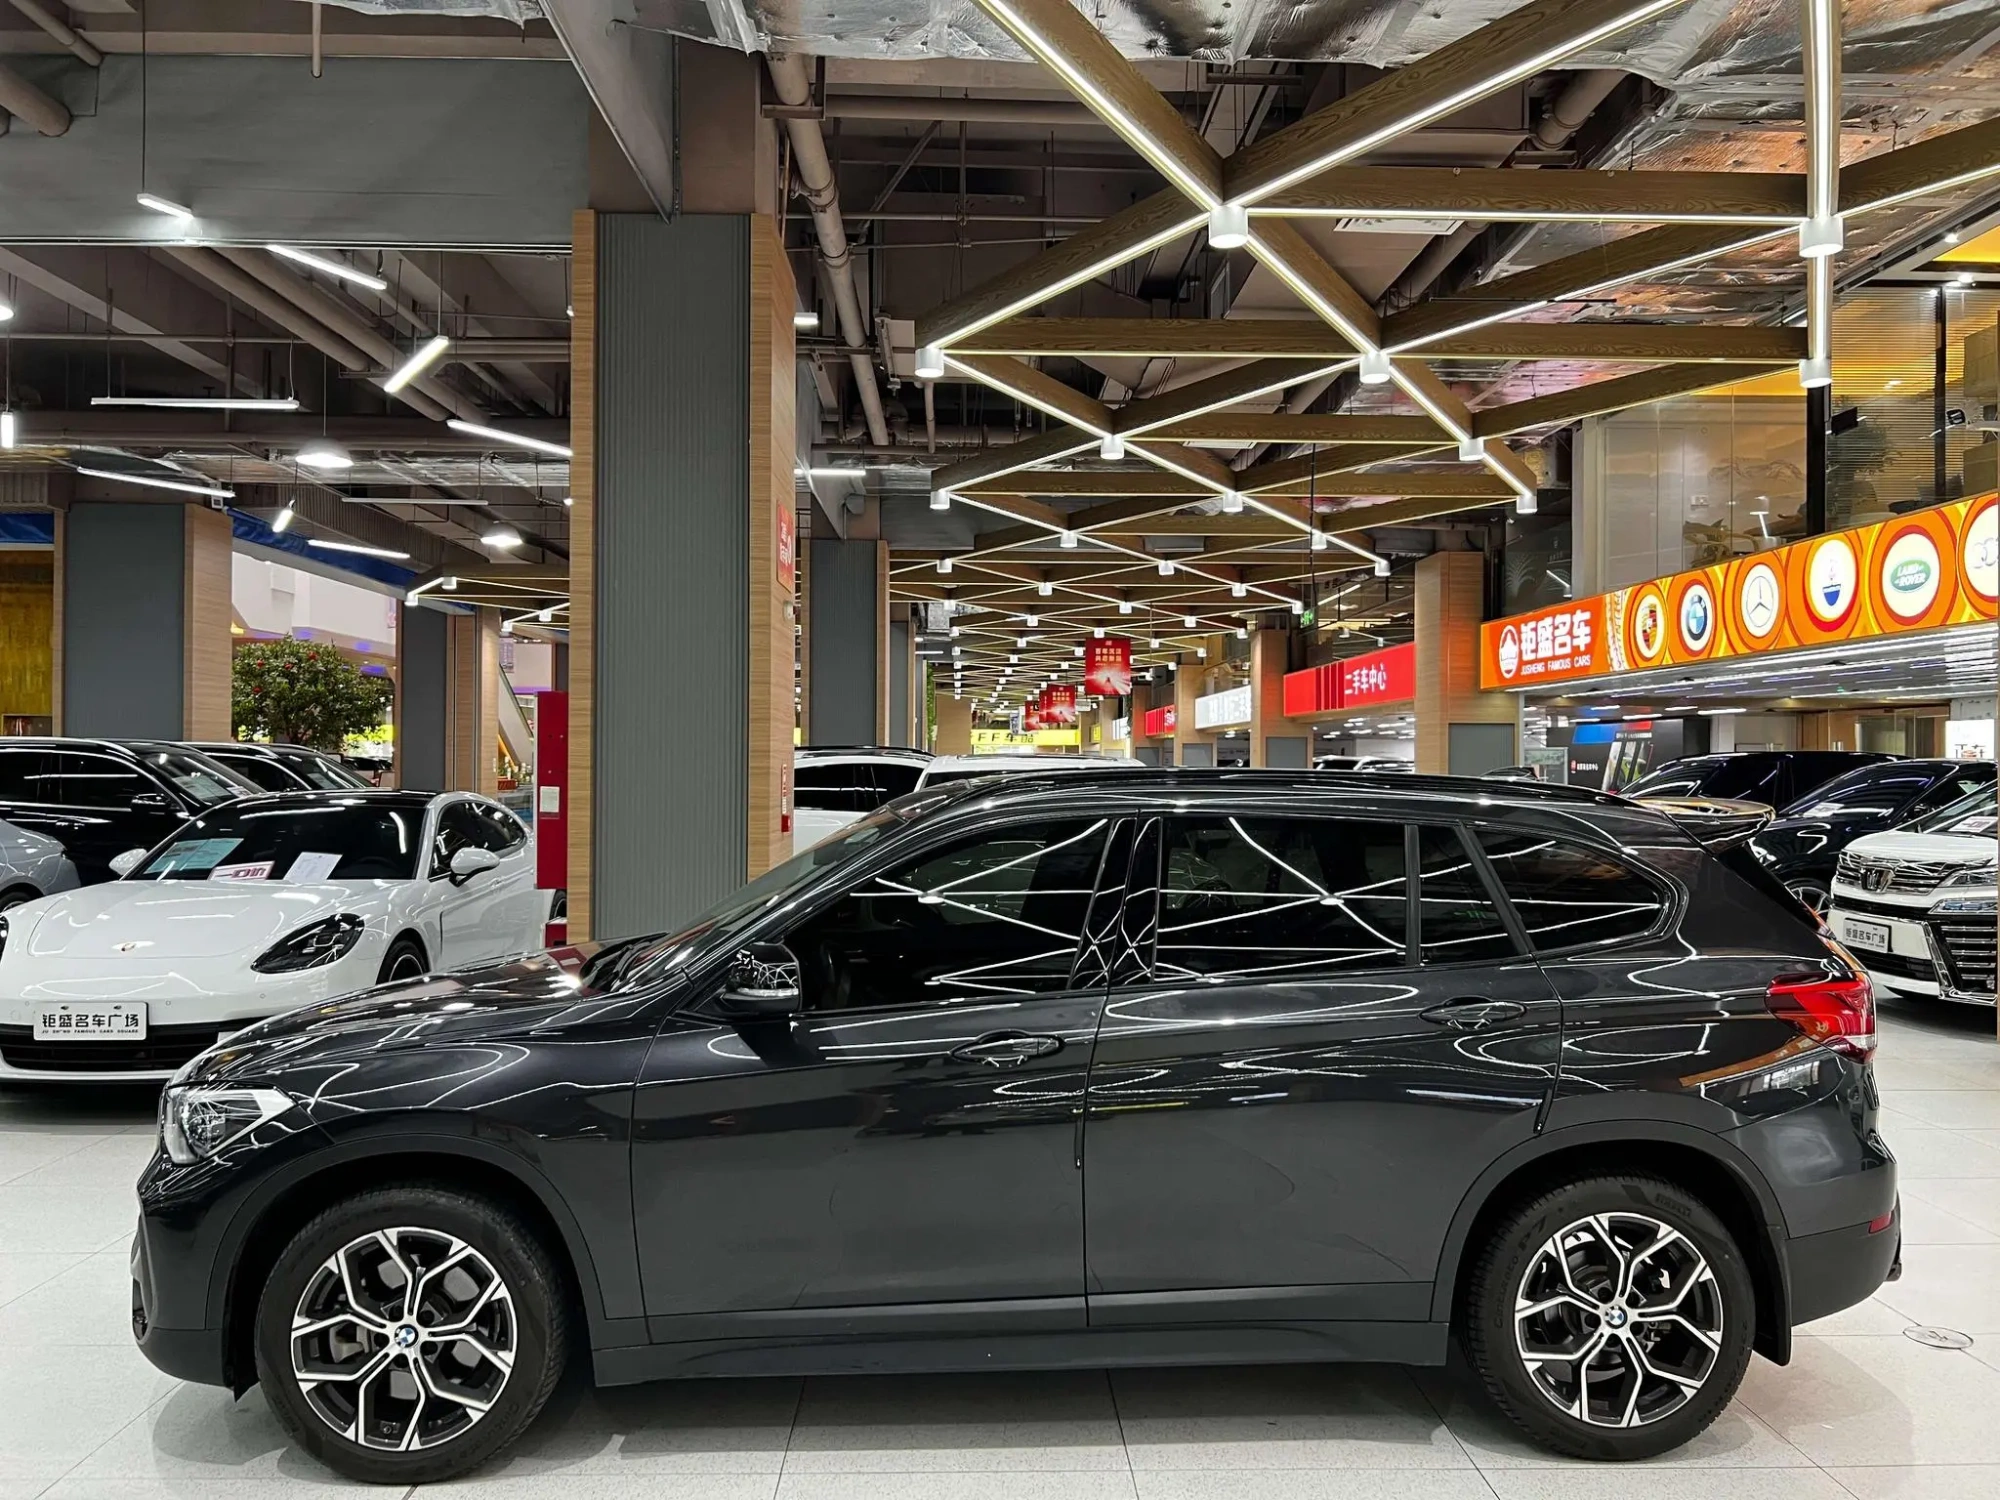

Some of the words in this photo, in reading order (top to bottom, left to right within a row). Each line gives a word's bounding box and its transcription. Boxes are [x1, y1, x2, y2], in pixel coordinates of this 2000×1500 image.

[1521, 662, 1545, 676] JUSHENG
[1547, 658, 1572, 671] FAMOUS
[1574, 655, 1591, 667] CARS
[1344, 663, 1387, 695] 二手车中心
[42, 1013, 139, 1028] 钜盛名车广场
